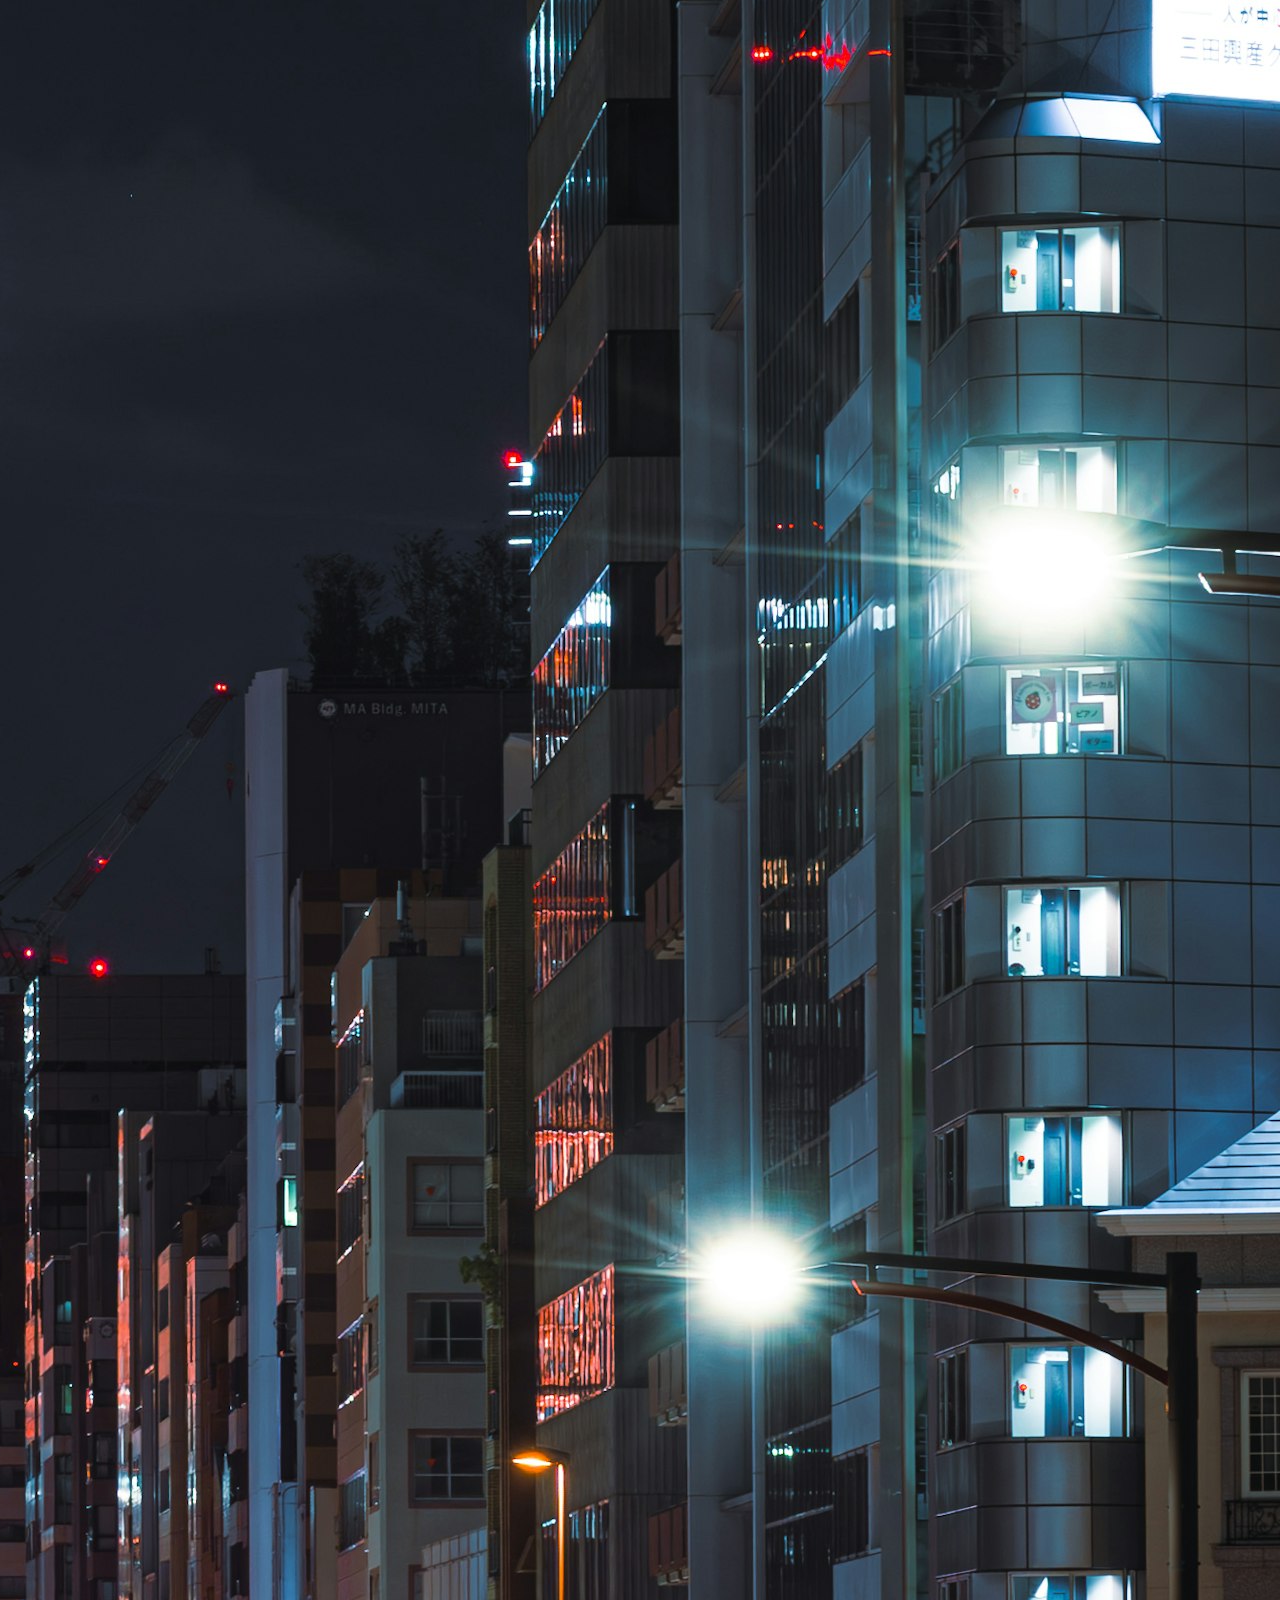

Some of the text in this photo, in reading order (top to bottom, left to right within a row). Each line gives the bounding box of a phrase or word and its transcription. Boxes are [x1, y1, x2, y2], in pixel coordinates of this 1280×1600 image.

[1223, 5, 1280, 27] 人が中
[343, 702, 449, 717] MA Bldg. MITA
